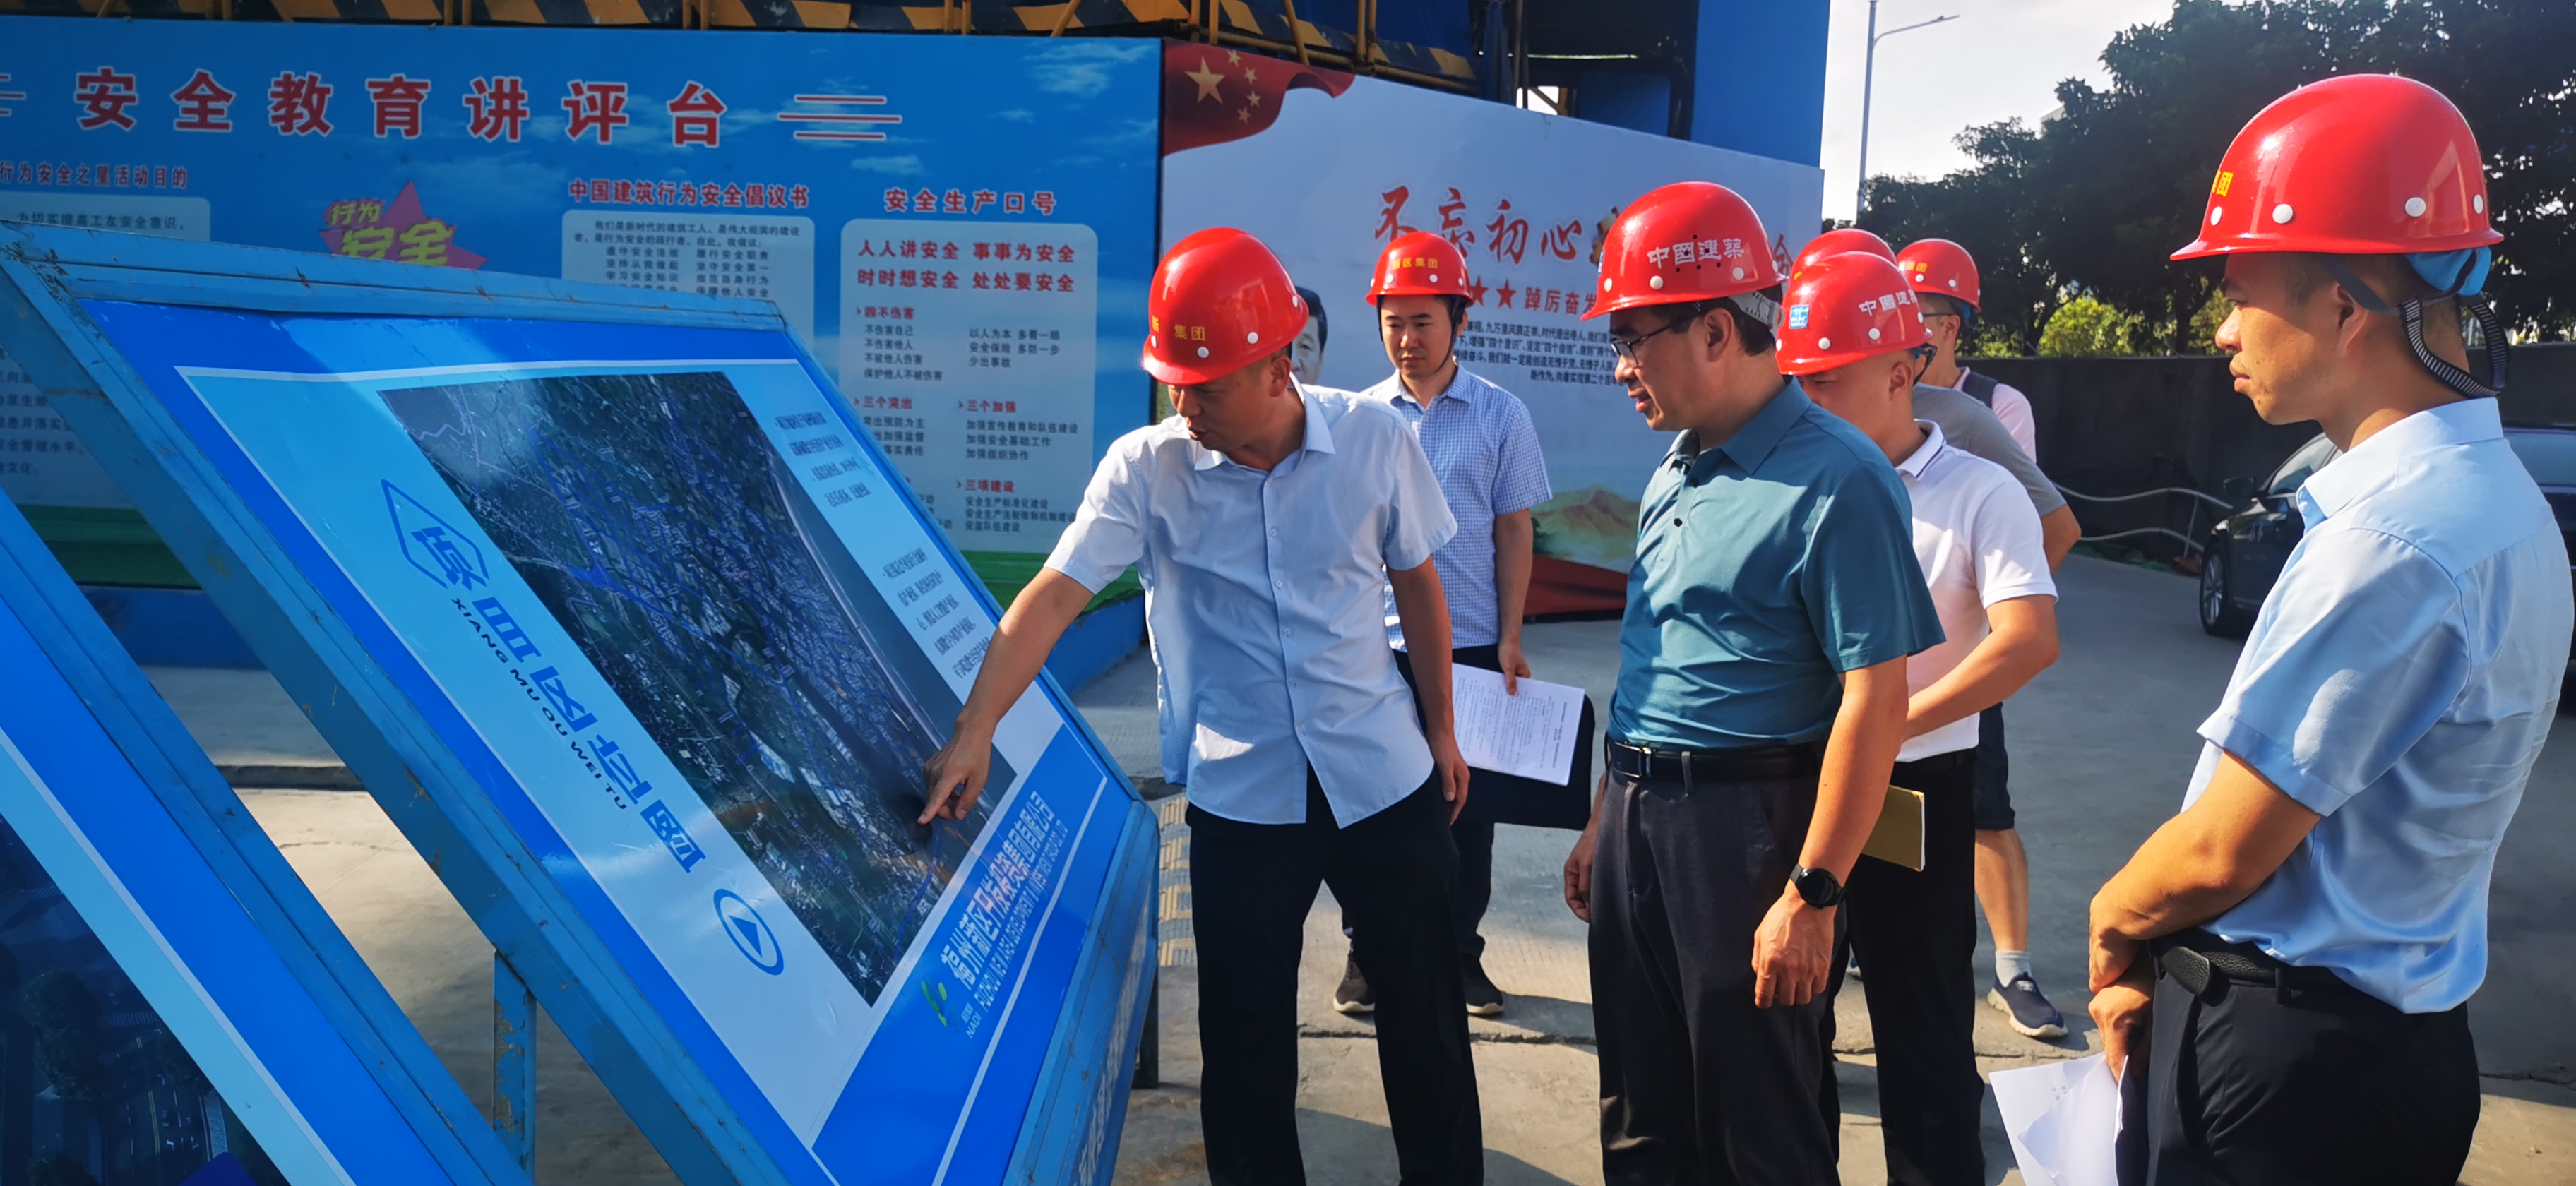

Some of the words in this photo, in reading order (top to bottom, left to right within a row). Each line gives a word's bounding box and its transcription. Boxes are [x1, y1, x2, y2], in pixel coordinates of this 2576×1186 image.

[74, 67, 727, 147] 安全教育讲评台
[568, 177, 810, 209] 中国建筑行为安全倡议书
[884, 187, 1056, 215] 安全生产口号
[857, 239, 960, 260] 人人讲安全
[972, 241, 1075, 263] 事事为安全
[857, 268, 960, 289] 时时想安全
[972, 272, 1075, 292] 处处要安全
[864, 306, 915, 320] 四不伤害
[968, 328, 1012, 339] 以人为本
[864, 395, 913, 409] 三个突出
[967, 399, 1016, 413] 三个加强
[965, 479, 1015, 493] 三项建设
[452, 598, 508, 664] XIANG
[509, 669, 541, 702] MU
[542, 707, 569, 737] QU
[571, 741, 602, 779] WEI
[604, 784, 628, 811] TU
[940, 790, 1055, 991] 福州新区开发投资集团有限公司
[974, 968, 1001, 1012] FUZHOU
[966, 1013, 982, 1039] NADI
